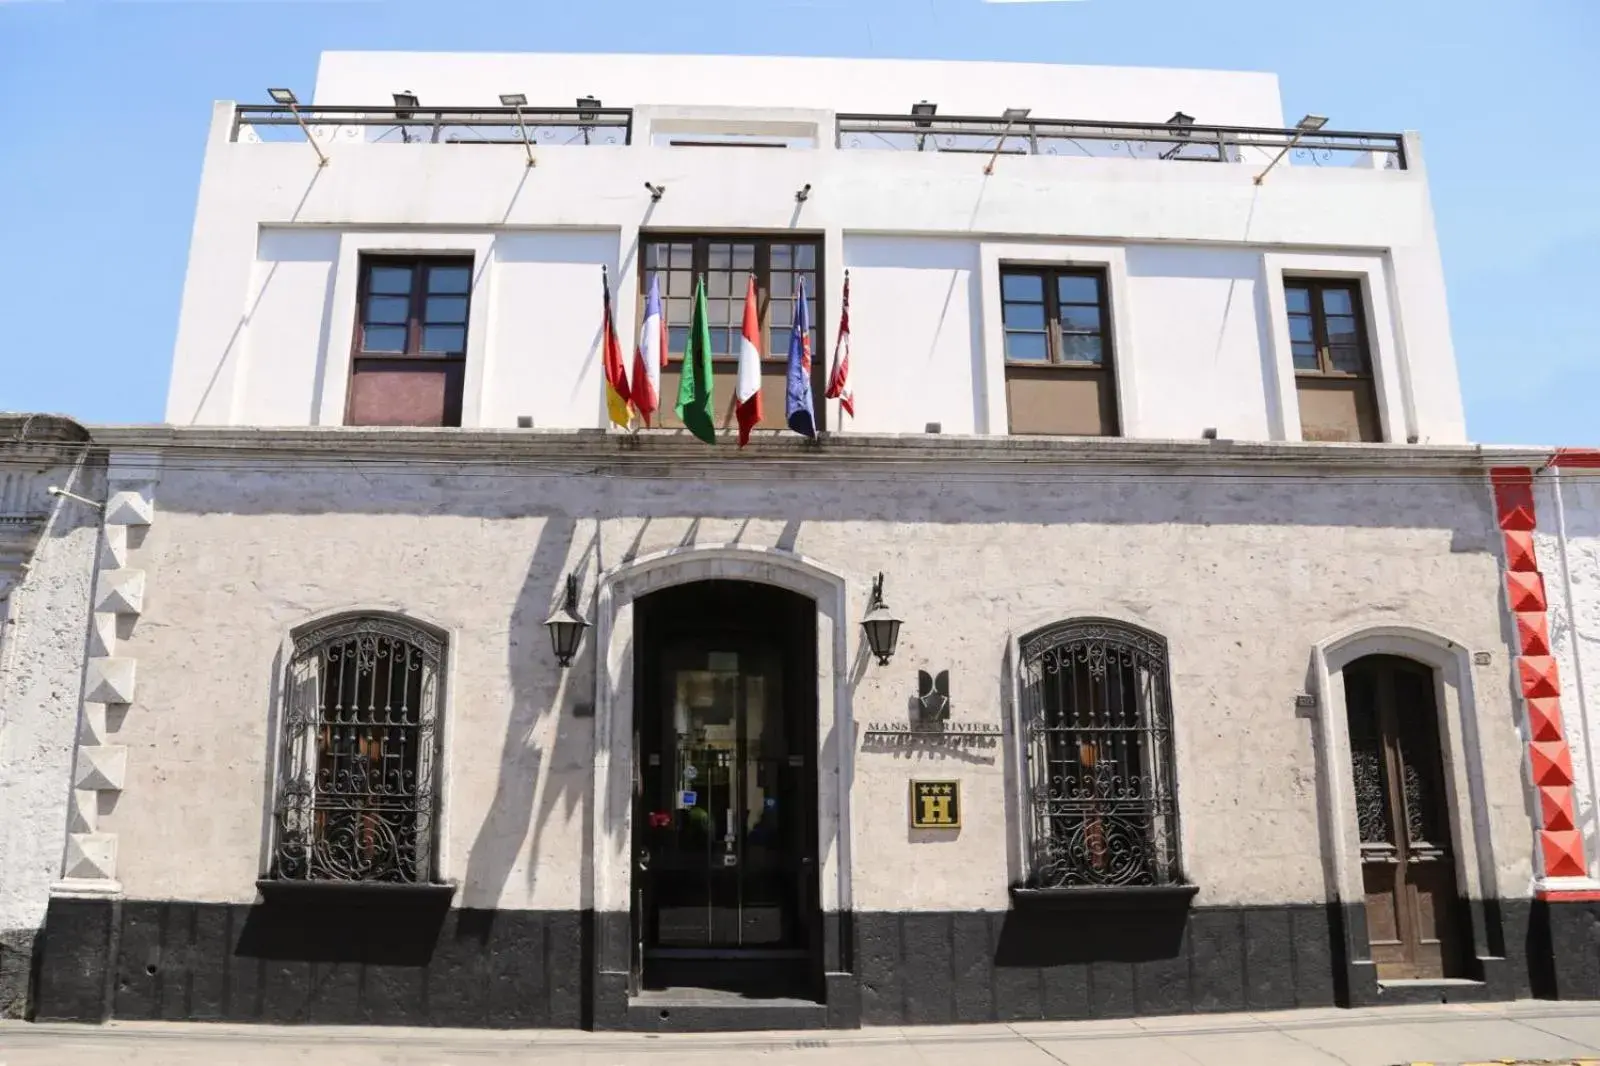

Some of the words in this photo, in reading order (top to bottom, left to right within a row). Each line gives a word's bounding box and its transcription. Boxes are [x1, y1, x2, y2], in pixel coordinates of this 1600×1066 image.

[867, 721, 936, 732] MANS
[942, 721, 1000, 732] RIVIERA
[921, 796, 952, 822] H
